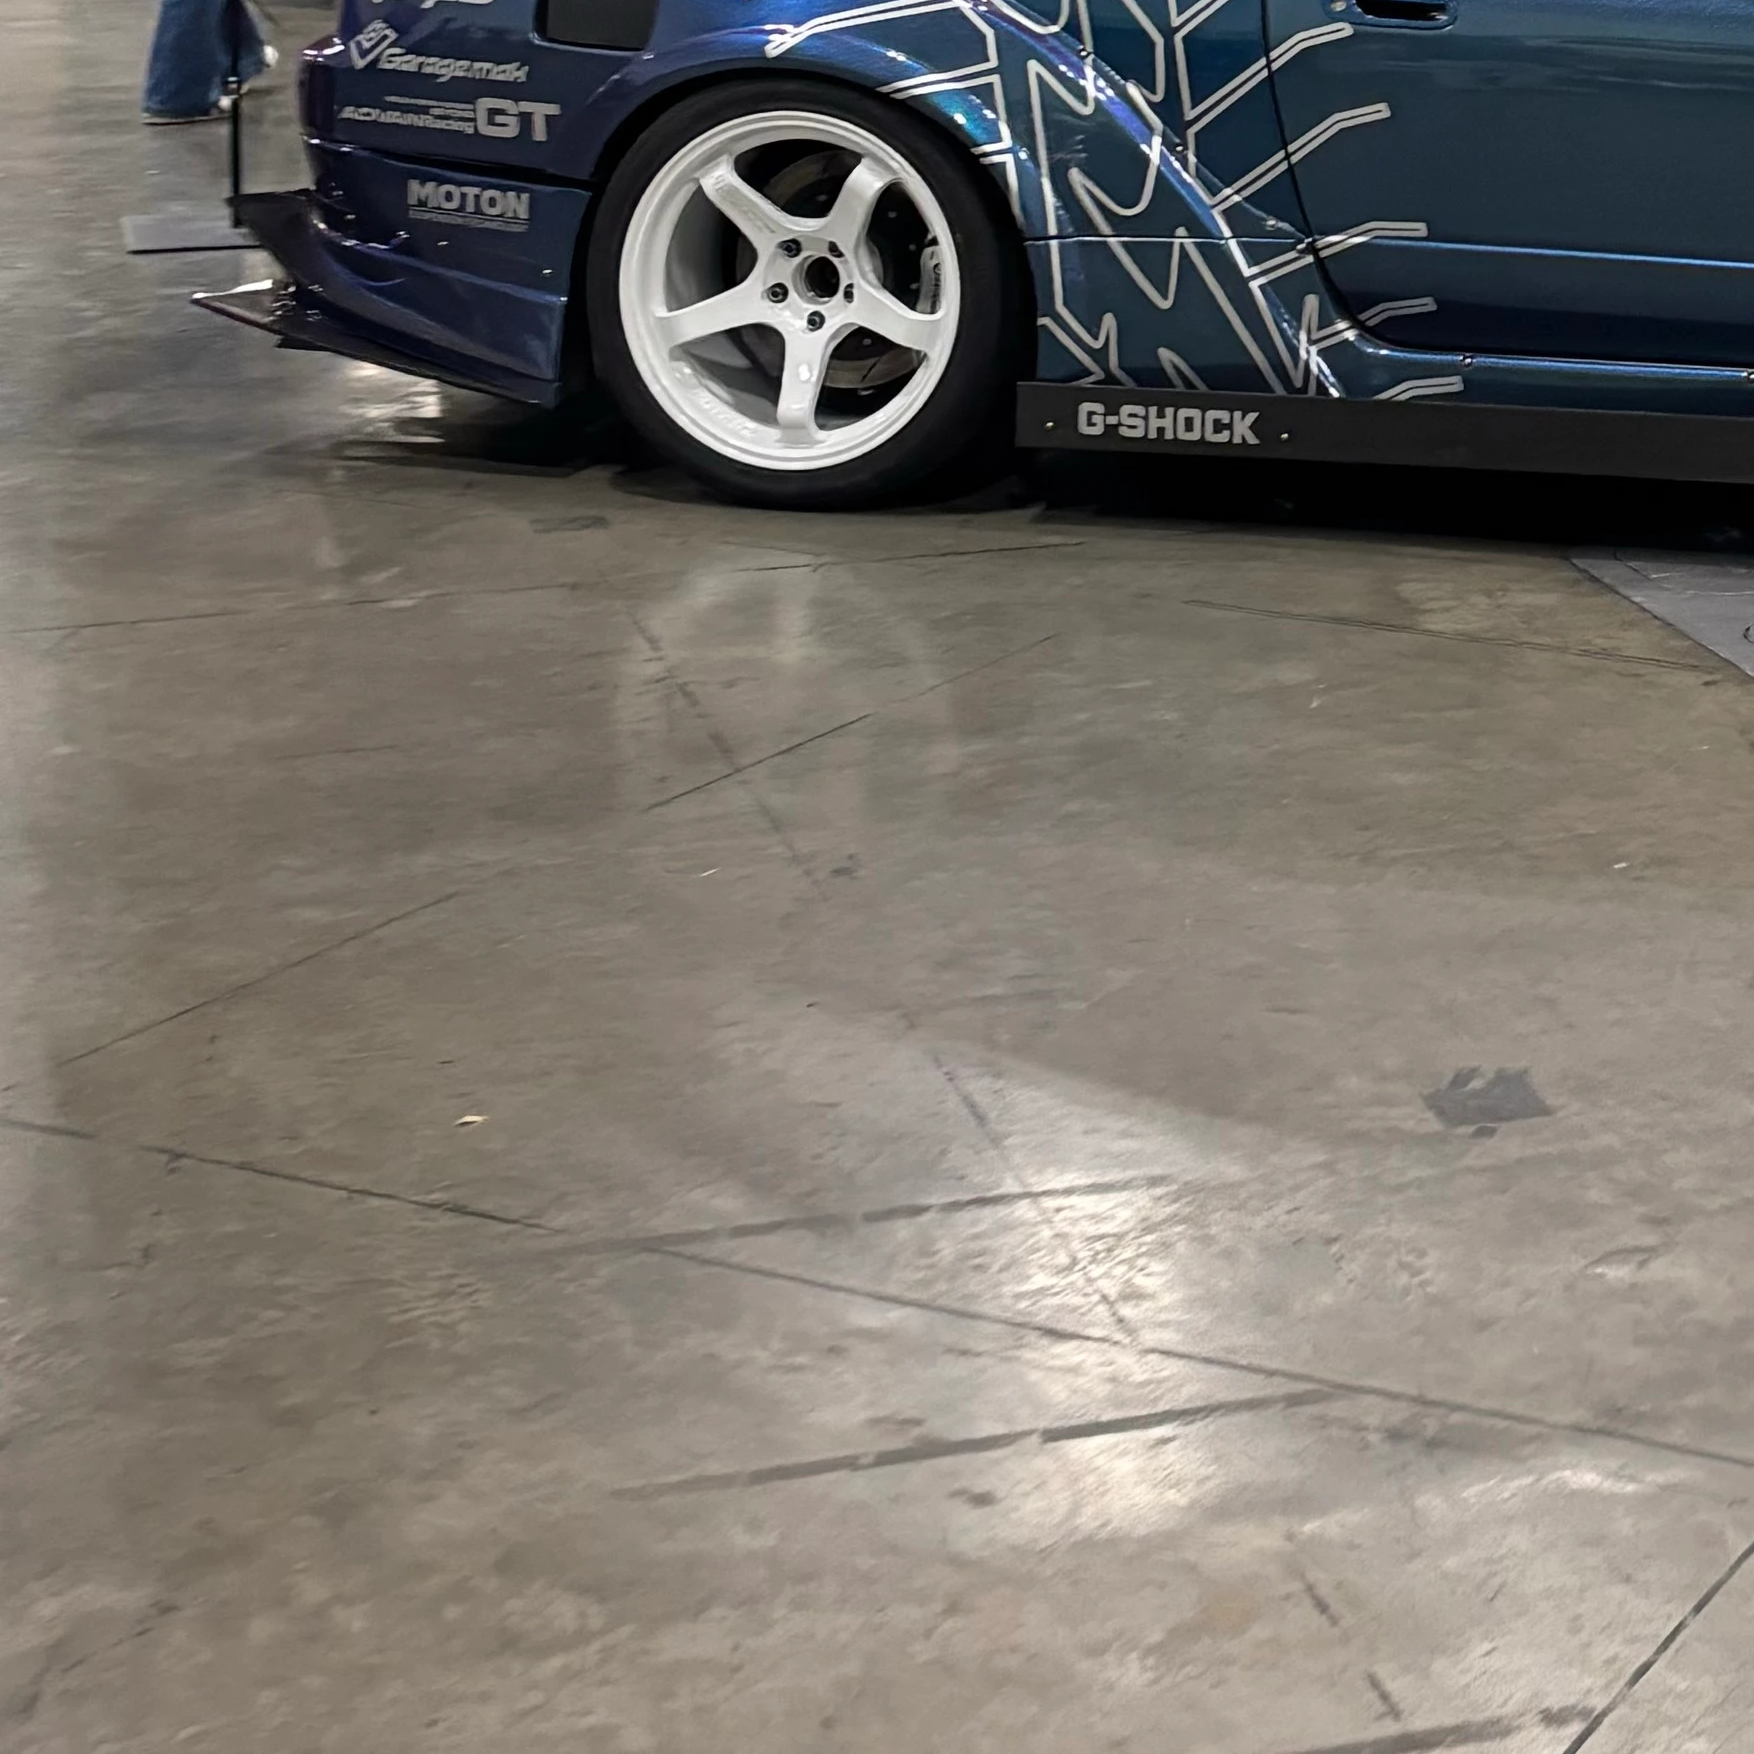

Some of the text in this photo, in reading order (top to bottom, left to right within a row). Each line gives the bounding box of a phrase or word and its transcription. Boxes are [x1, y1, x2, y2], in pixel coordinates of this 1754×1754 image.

[474, 97, 561, 142] GT
[407, 179, 530, 220] MOTON
[1077, 401, 1261, 445] G-SHOCK
